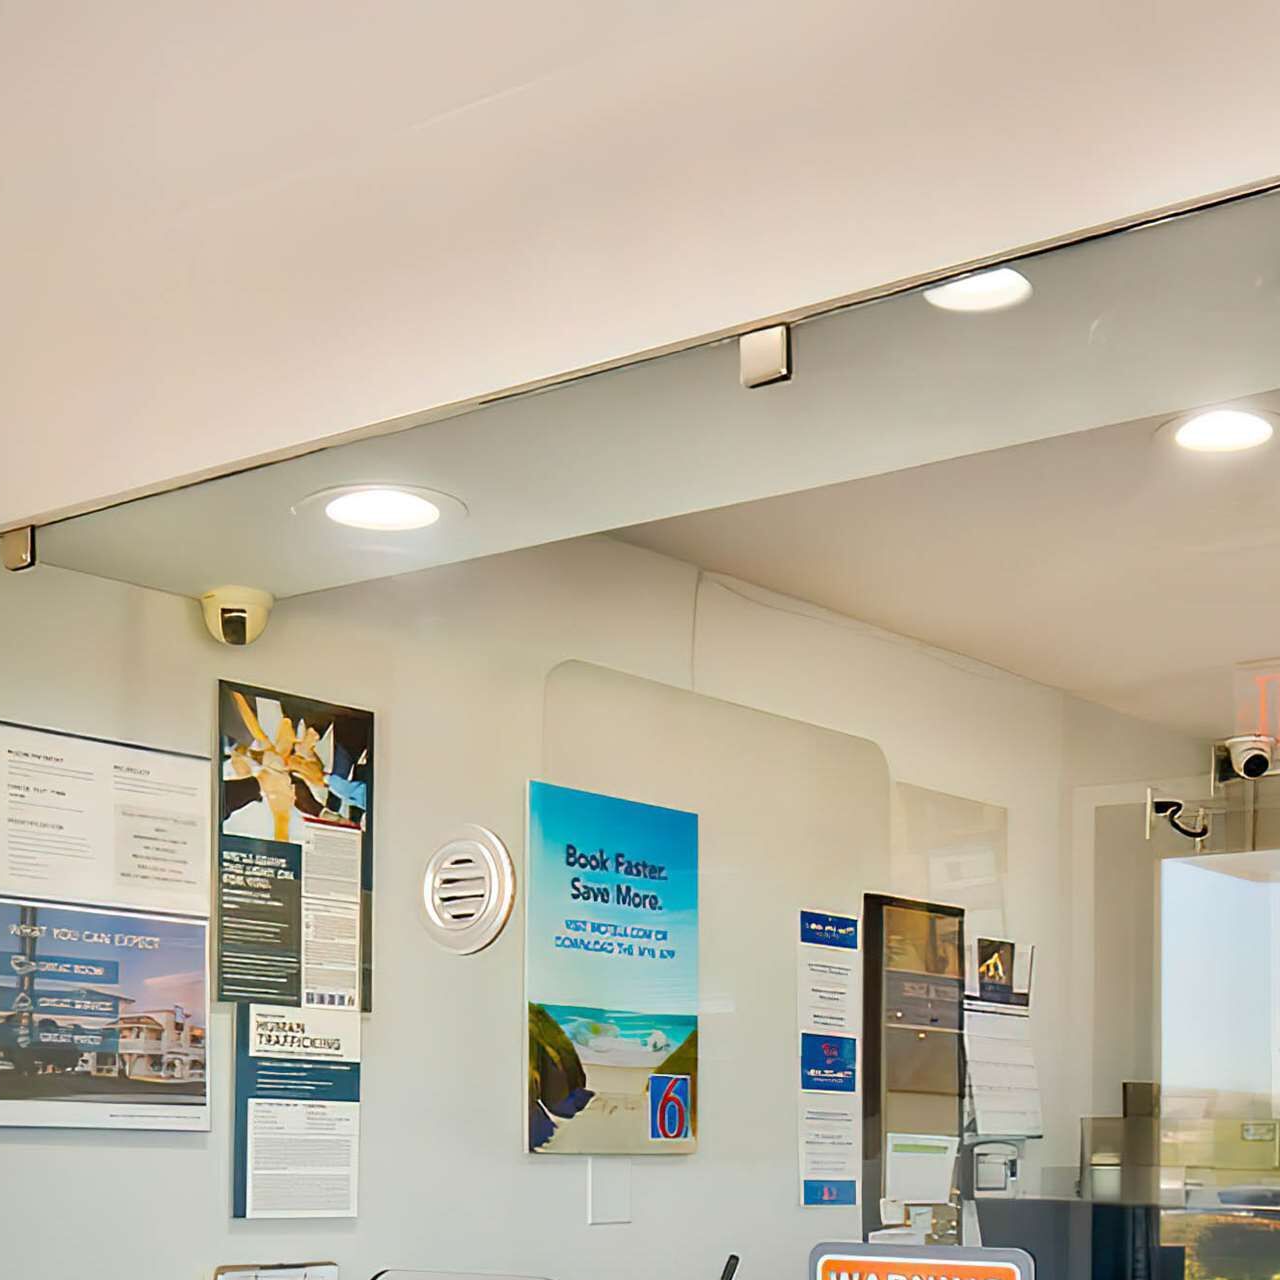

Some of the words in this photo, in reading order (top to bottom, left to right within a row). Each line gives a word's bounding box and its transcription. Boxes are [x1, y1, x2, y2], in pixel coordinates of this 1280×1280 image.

[565, 843, 610, 872] Book
[614, 852, 669, 881] Faster.
[570, 876, 610, 904] Save
[616, 883, 663, 911] More.
[52, 927, 80, 942] YOU
[82, 931, 112, 945] CAN
[657, 1076, 687, 1139] 6
